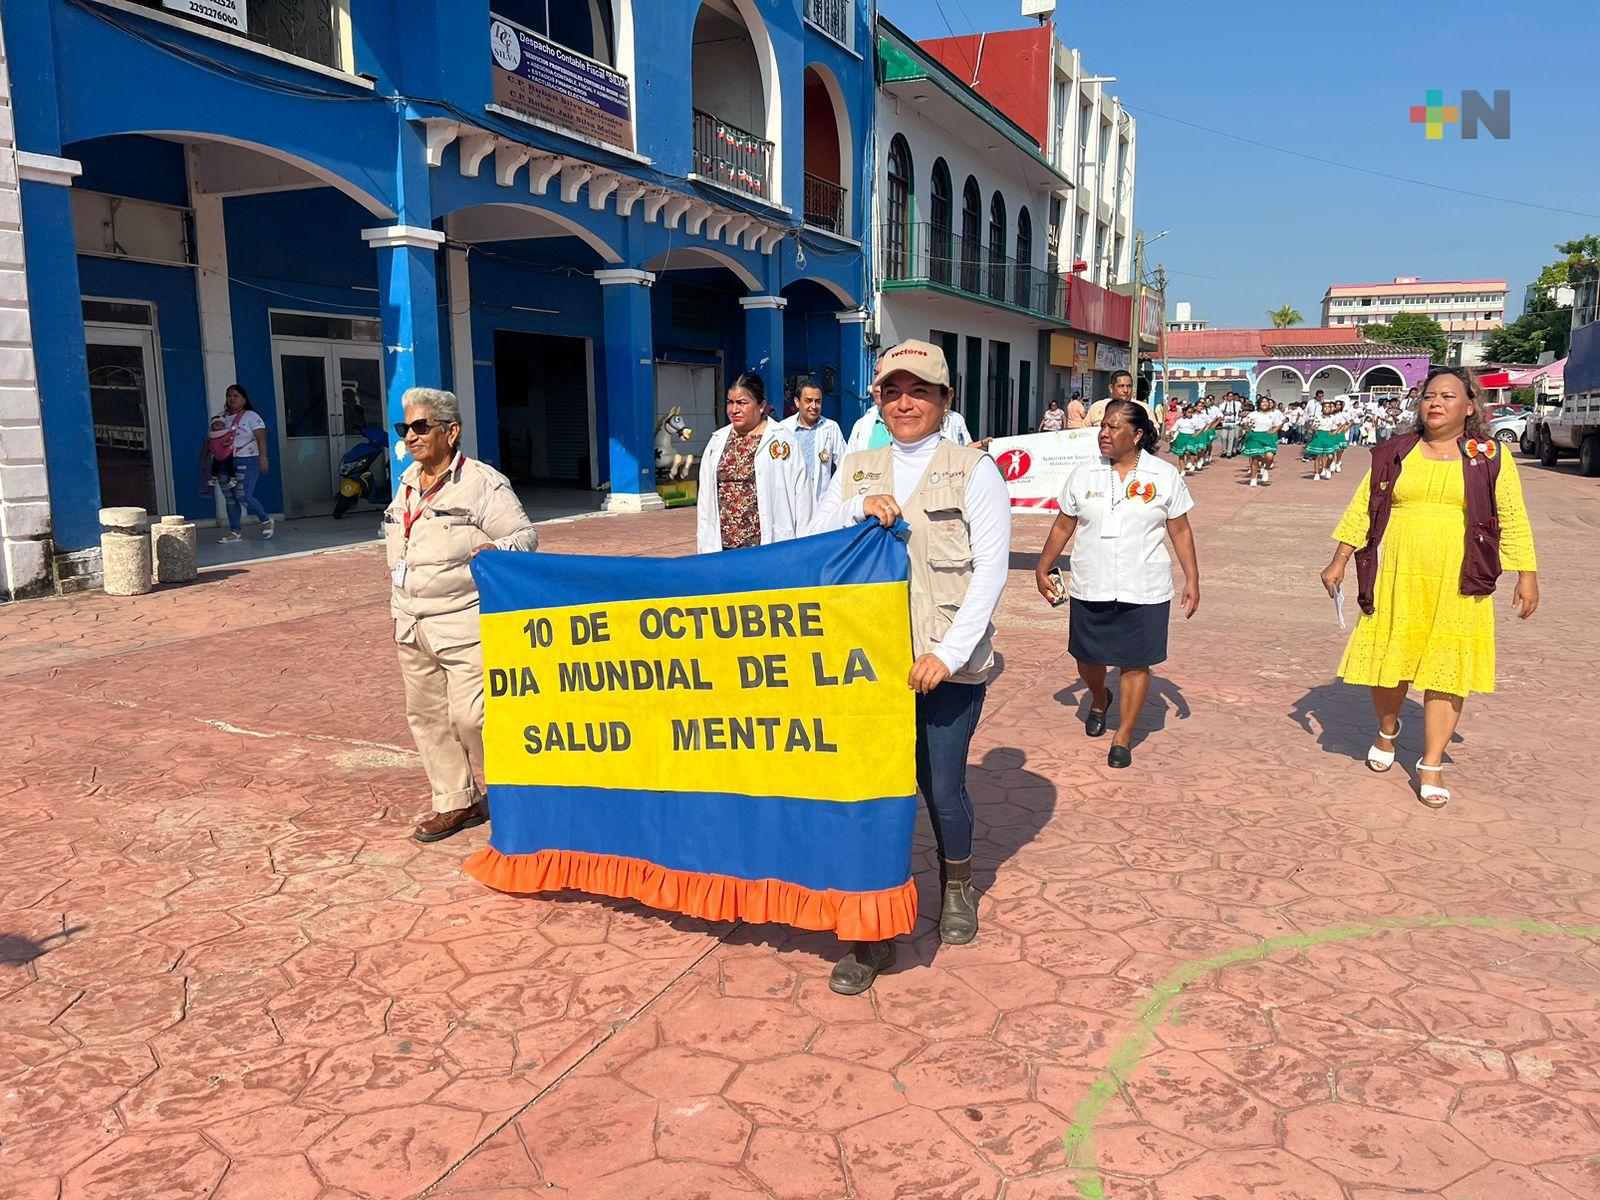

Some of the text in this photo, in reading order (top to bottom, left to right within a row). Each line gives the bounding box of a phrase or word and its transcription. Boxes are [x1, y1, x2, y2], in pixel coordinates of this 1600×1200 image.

[189, 1, 238, 26] 2292276000
[494, 47, 518, 65] SILVA
[520, 32, 554, 57] Despacho
[556, 48, 585, 70] Contable
[523, 602, 824, 648] 10 DE OCTUBRE
[490, 648, 879, 698] DIA MUNDIAL DE LA
[523, 717, 838, 755] SALUD MENTAL
